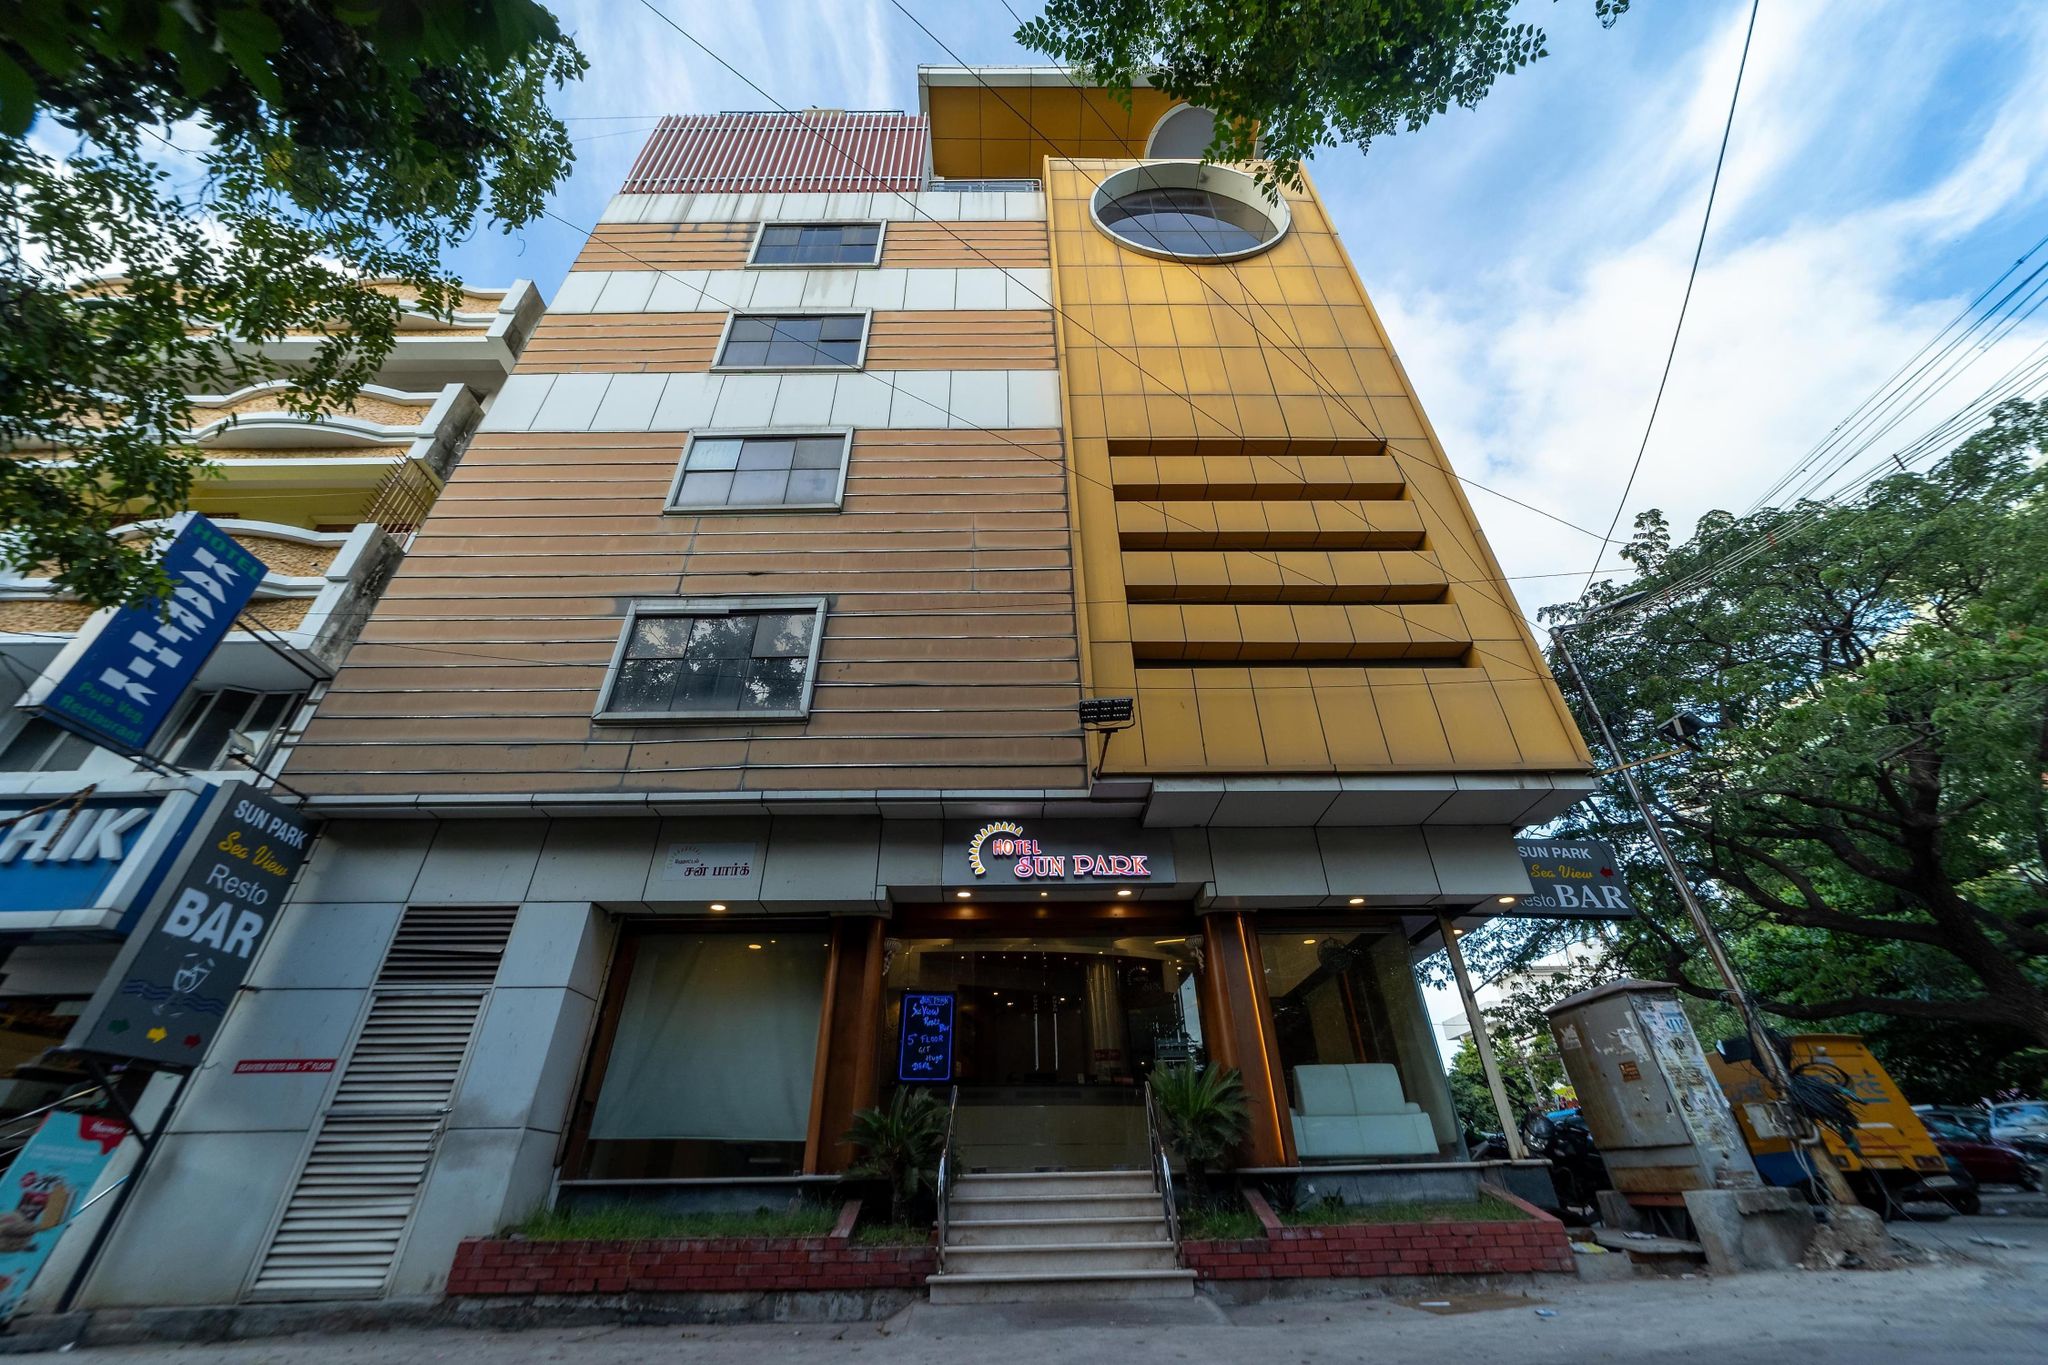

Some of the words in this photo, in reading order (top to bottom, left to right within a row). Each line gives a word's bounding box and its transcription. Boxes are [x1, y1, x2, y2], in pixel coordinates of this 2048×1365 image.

[193, 523, 260, 579] HOTEL
[99, 547, 240, 706] KAARTHIK
[79, 681, 115, 711] Pure
[59, 694, 143, 743] Restaurant
[0, 808, 150, 863] HIK
[234, 799, 270, 830] SUN
[265, 817, 307, 849] PARK
[217, 831, 248, 860] Sea
[253, 845, 289, 877] View
[992, 838, 1042, 856] HOTEL
[1517, 845, 1549, 858] SUN
[1552, 846, 1593, 859] PARK
[205, 862, 269, 906] Resto
[684, 863, 709, 877] சன்
[712, 862, 750, 877] பார்க்
[1014, 855, 1065, 878] SUN
[1072, 854, 1151, 877] PARK
[1530, 863, 1556, 878] Sea
[1558, 864, 1594, 879] View
[1520, 893, 1557, 908] esto
[1552, 884, 1629, 909] BAR
[161, 886, 265, 959] BAR
[921, 1034, 944, 1043] FLOOR
